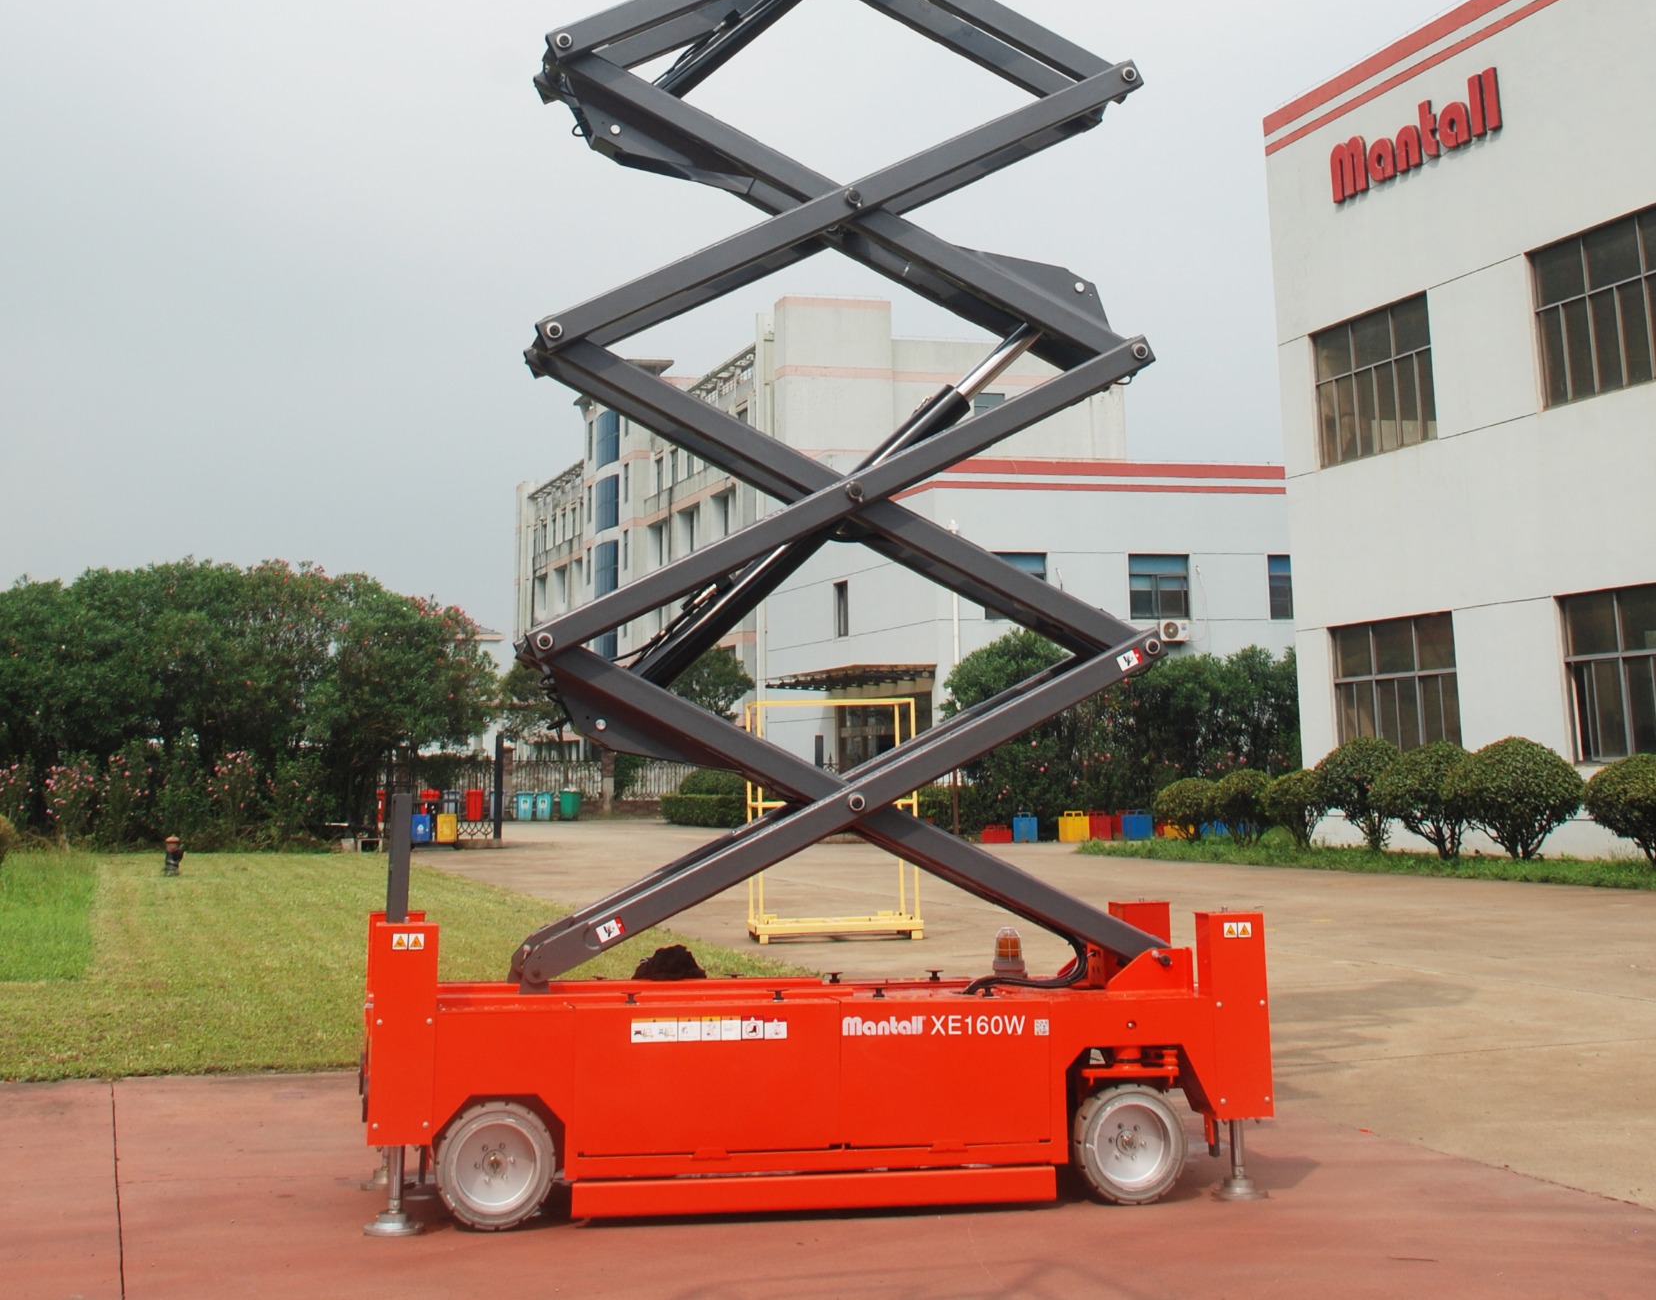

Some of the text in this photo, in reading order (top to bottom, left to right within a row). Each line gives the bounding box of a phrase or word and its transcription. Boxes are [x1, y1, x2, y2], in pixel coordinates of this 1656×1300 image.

[1330, 67, 1502, 204] Mantall
[842, 1015, 1026, 1036] Mantall XE160W
